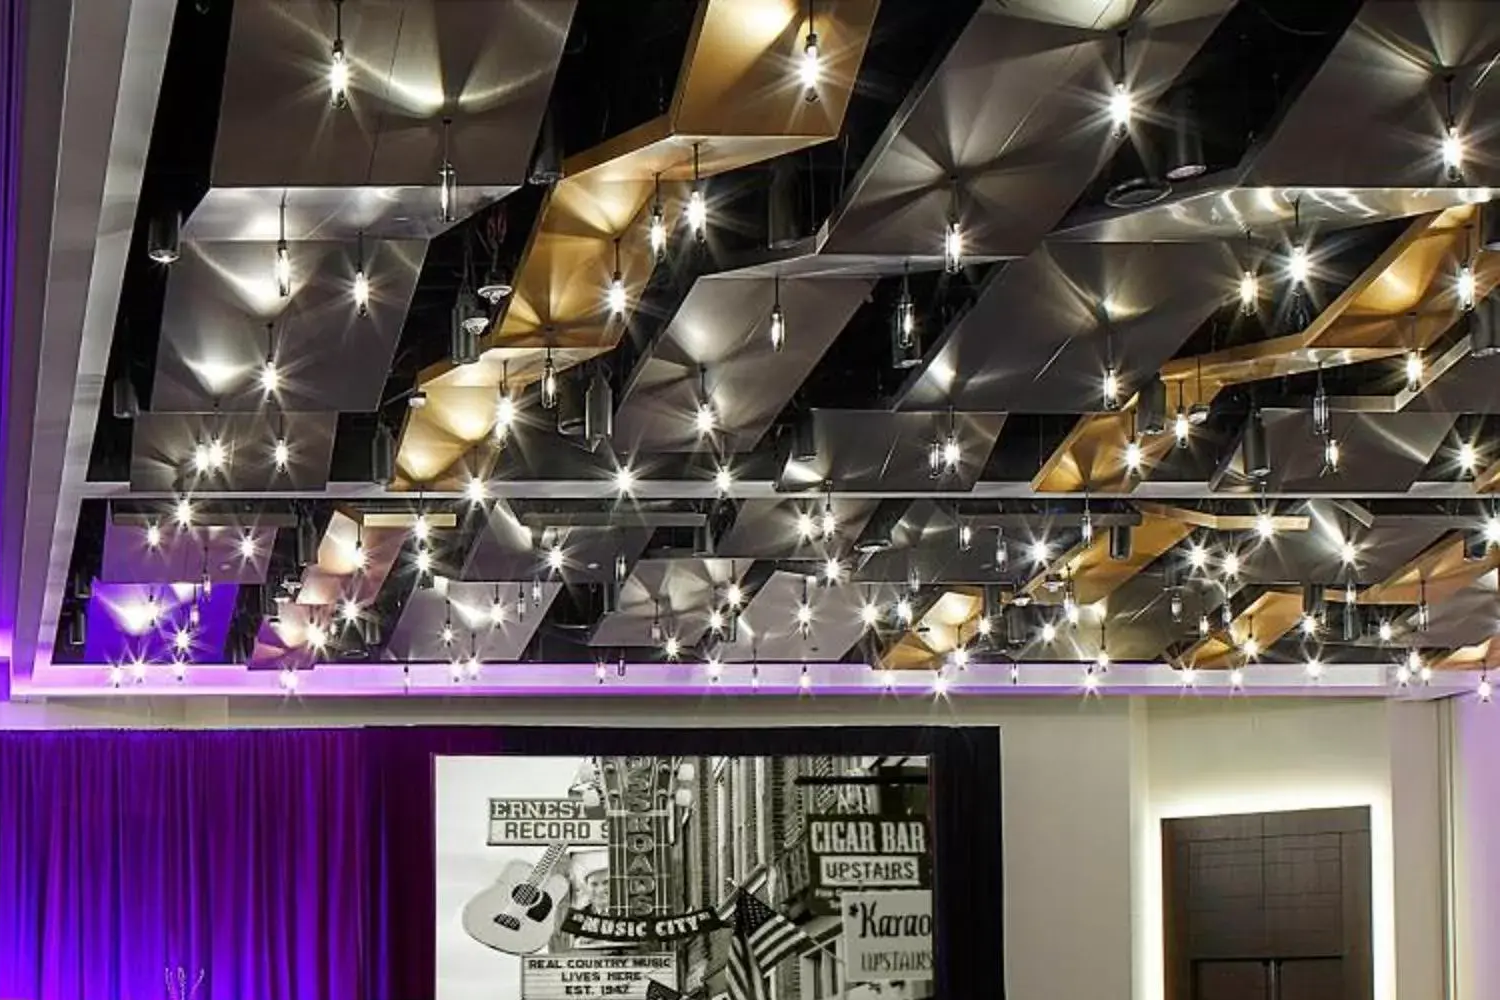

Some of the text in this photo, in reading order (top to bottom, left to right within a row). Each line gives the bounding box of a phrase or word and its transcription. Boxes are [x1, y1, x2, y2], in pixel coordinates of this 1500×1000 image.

[505, 822, 591, 839] RECORD
[811, 821, 927, 854] CIGAR BAR
[826, 862, 915, 880] UPSTAIRS
[528, 958, 672, 969] REAL COUNTRY MUSIC
[561, 972, 642, 982] LIVES HERE
[565, 985, 595, 995] EST.
